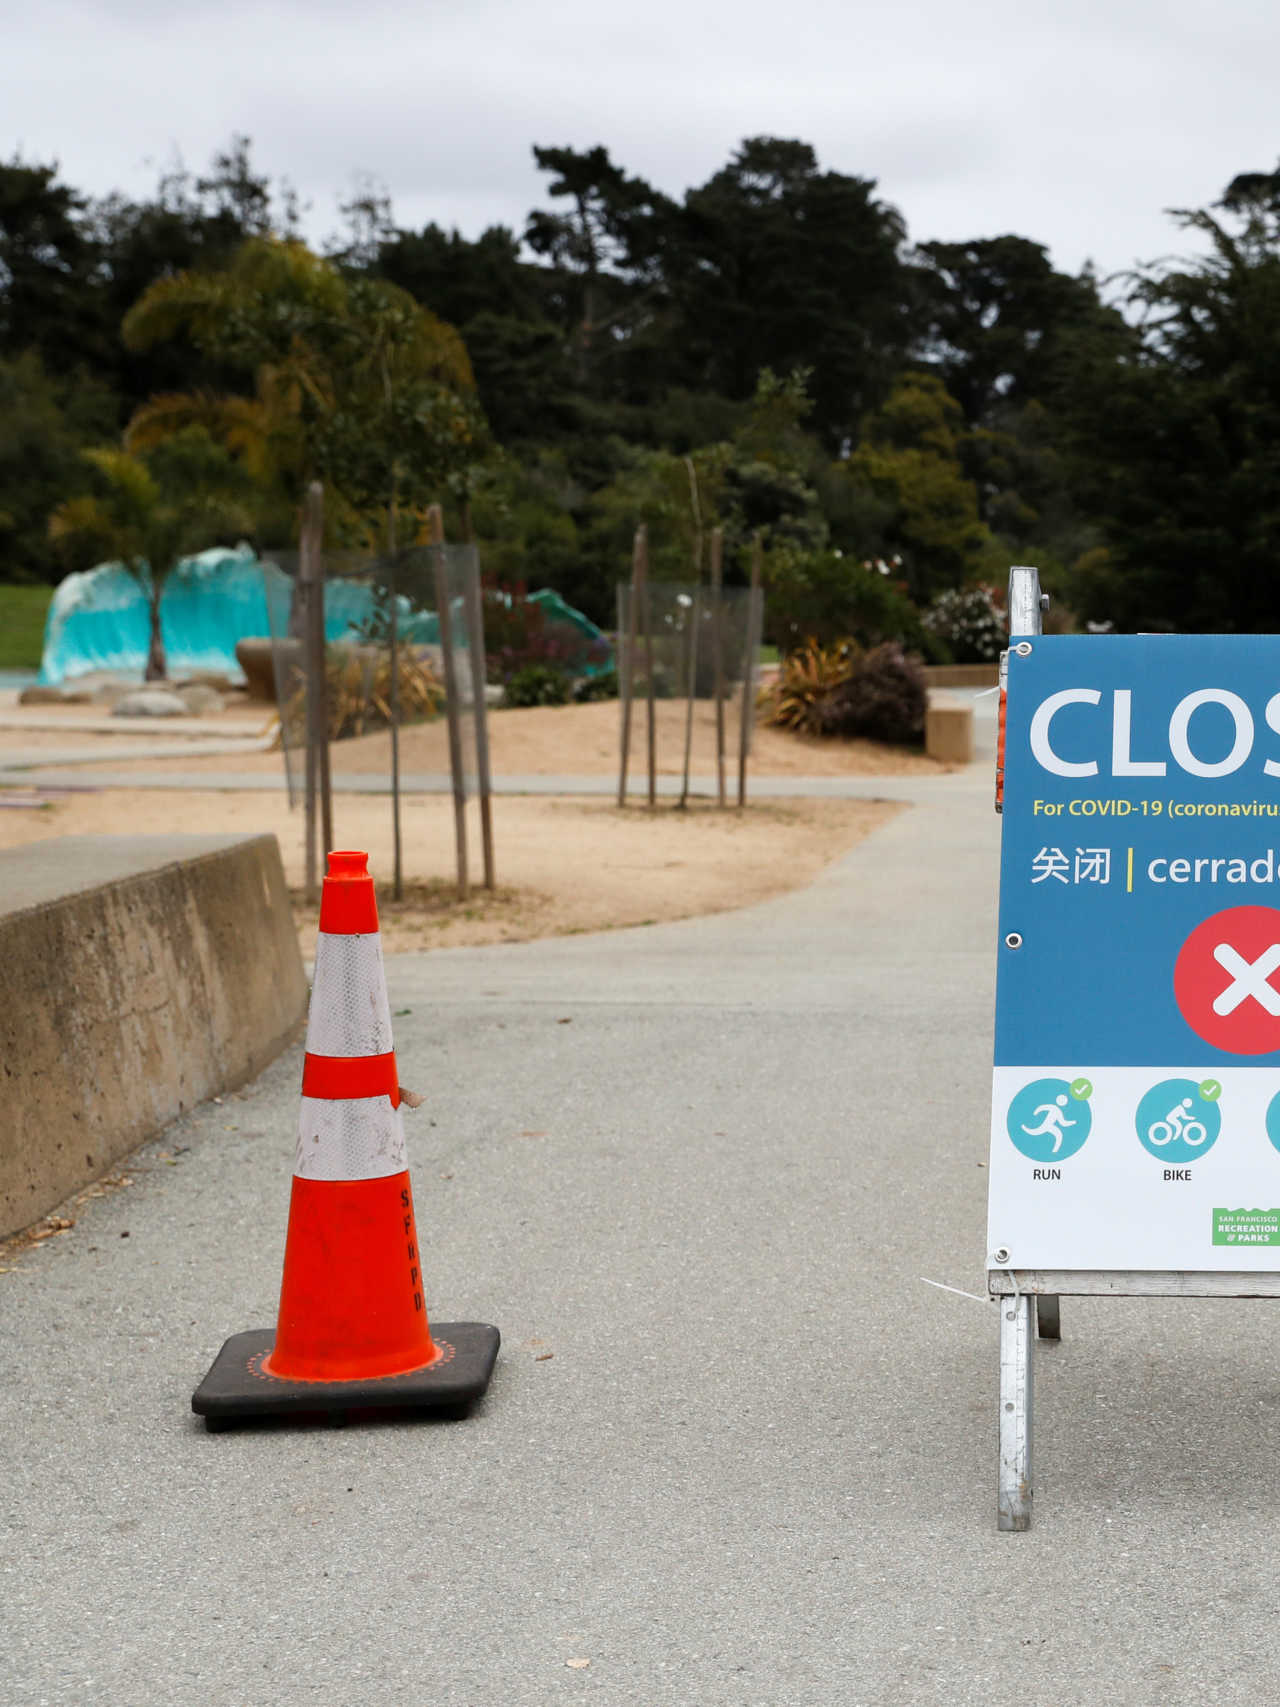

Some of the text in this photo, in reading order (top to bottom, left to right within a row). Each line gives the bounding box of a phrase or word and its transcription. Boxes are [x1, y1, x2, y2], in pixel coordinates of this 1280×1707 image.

[1033, 799, 1065, 817] For
[1069, 799, 1163, 818] COVID-19
[1031, 847, 1111, 885] 关闭
[1033, 1169, 1061, 1181] RUN
[1163, 1169, 1192, 1182] BIKE
[1218, 1225, 1279, 1233] RECREATION
[1238, 1234, 1271, 1242] PARKS
